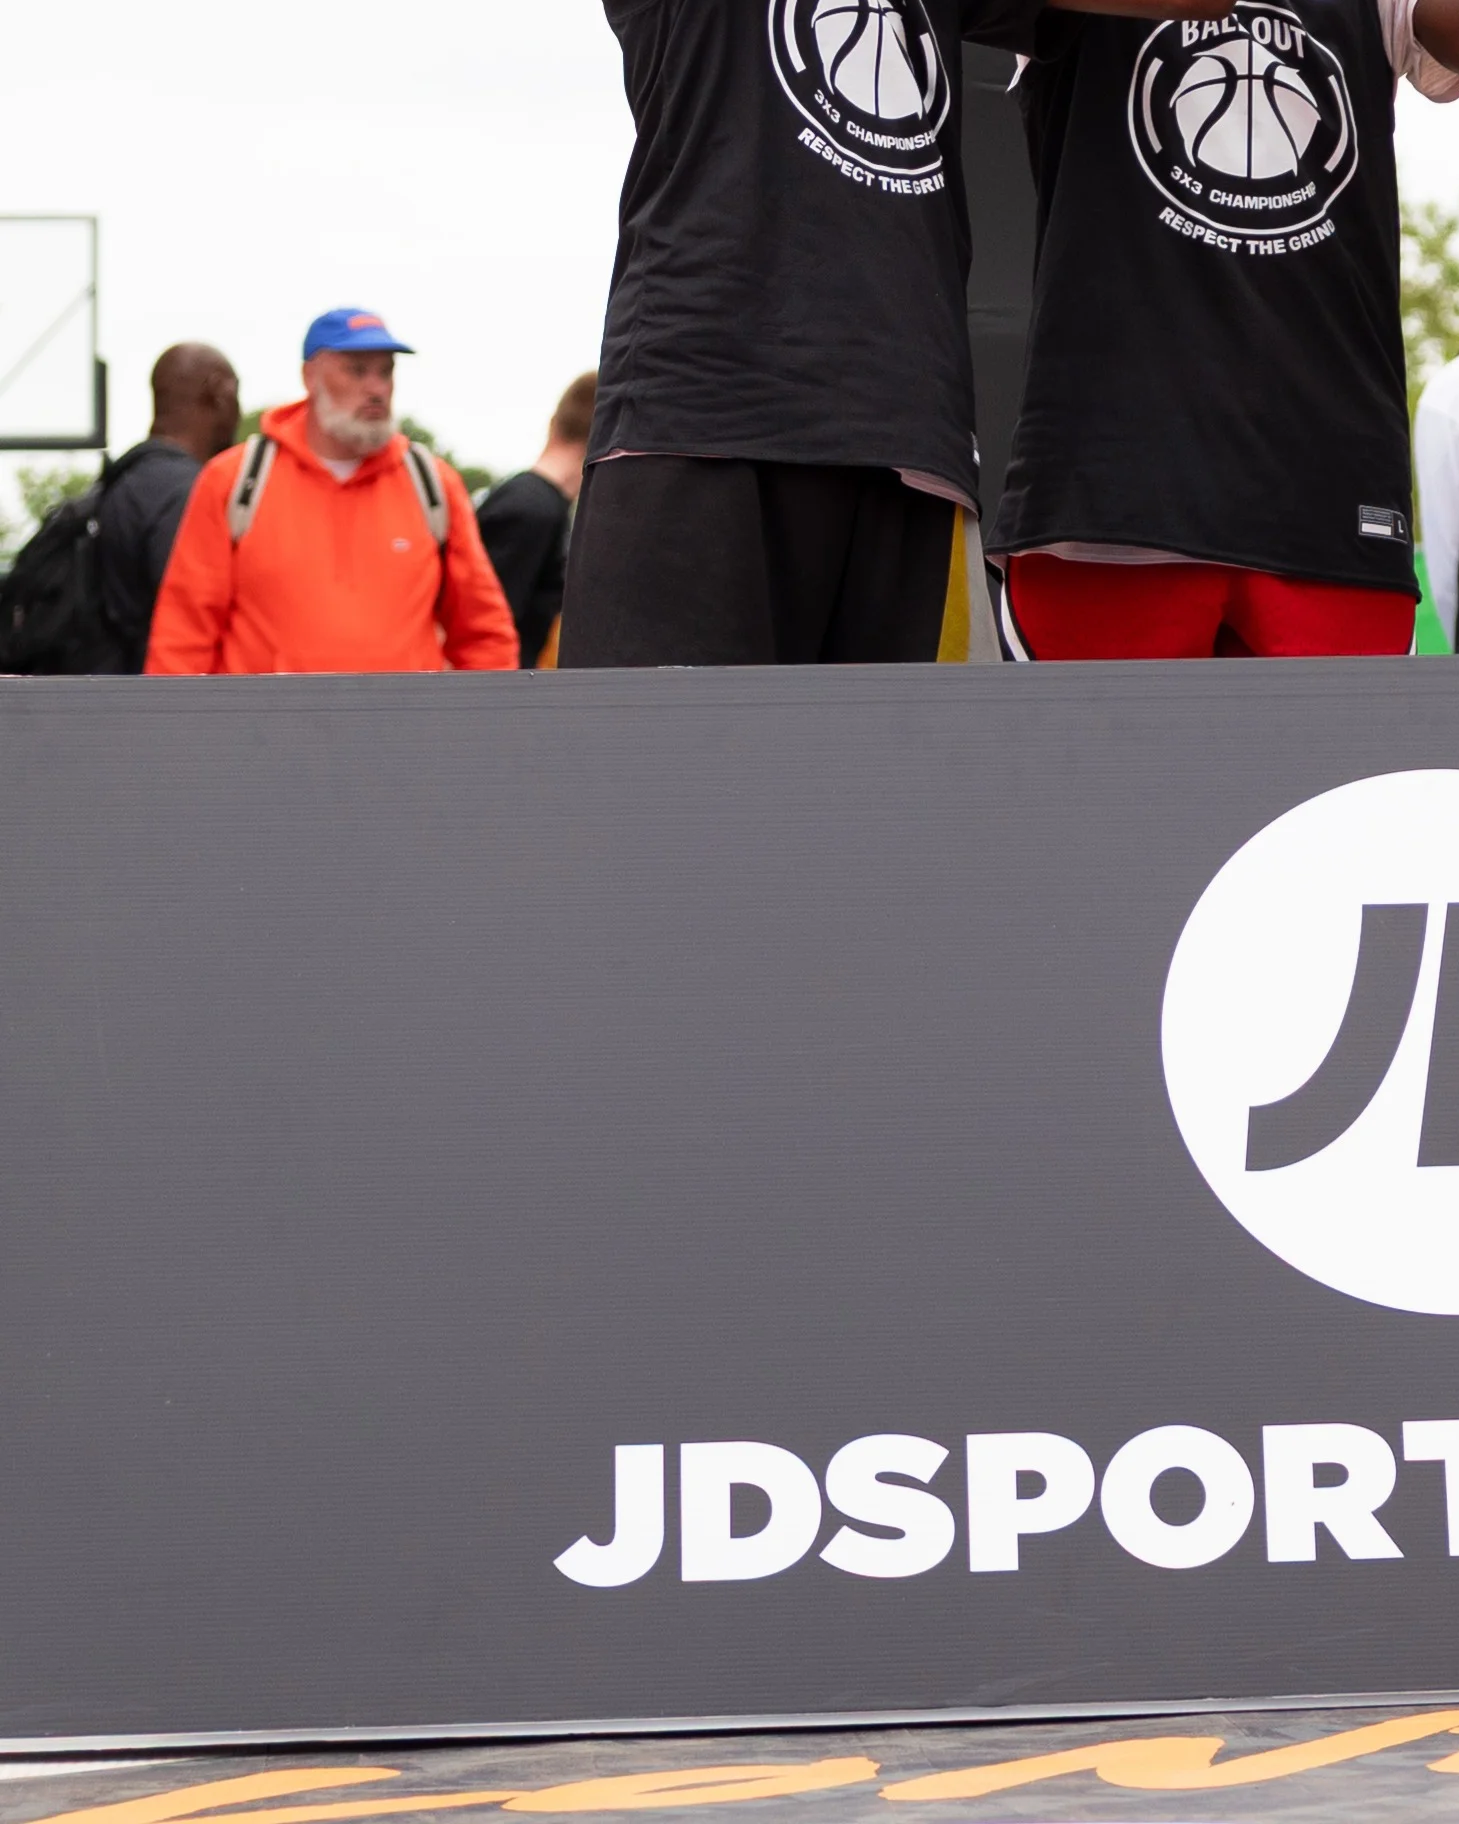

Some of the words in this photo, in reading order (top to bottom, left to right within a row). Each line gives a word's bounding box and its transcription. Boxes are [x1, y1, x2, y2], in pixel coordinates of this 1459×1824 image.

[1251, 16, 1306, 58] OUT
[846, 121, 937, 151] CHAMPIONSH
[797, 127, 876, 187] RESPECT
[878, 176, 913, 194] THE
[1170, 165, 1204, 195] 3X3
[1209, 181, 1317, 210] CHAMPIONSHIP
[1158, 206, 1242, 253] RESPECT
[1245, 239, 1287, 255] THE
[1288, 218, 1336, 252] GRIND
